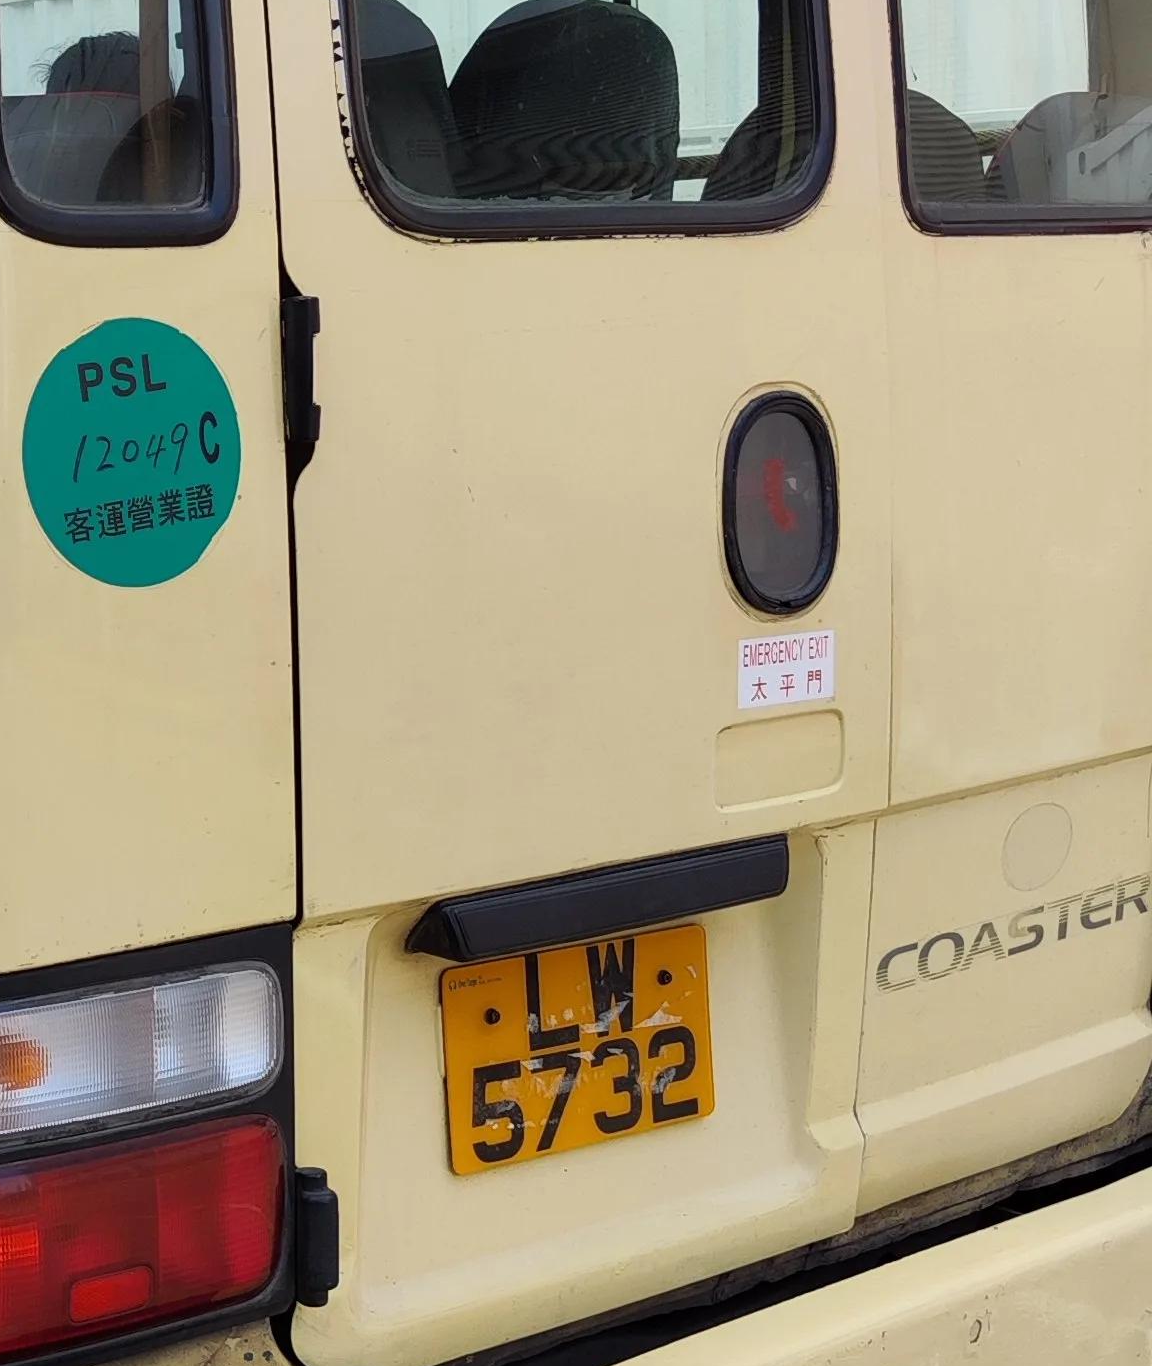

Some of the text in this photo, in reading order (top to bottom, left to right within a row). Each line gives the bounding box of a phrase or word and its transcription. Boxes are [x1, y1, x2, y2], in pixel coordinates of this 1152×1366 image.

[77, 353, 167, 402] PSL
[64, 484, 215, 544] 客運營業證
[743, 635, 829, 668] EMERGENCY EXIT
[750, 669, 823, 702] 太平門
[875, 873, 1152, 993] COASTER
[472, 1026, 698, 1163] 5732
